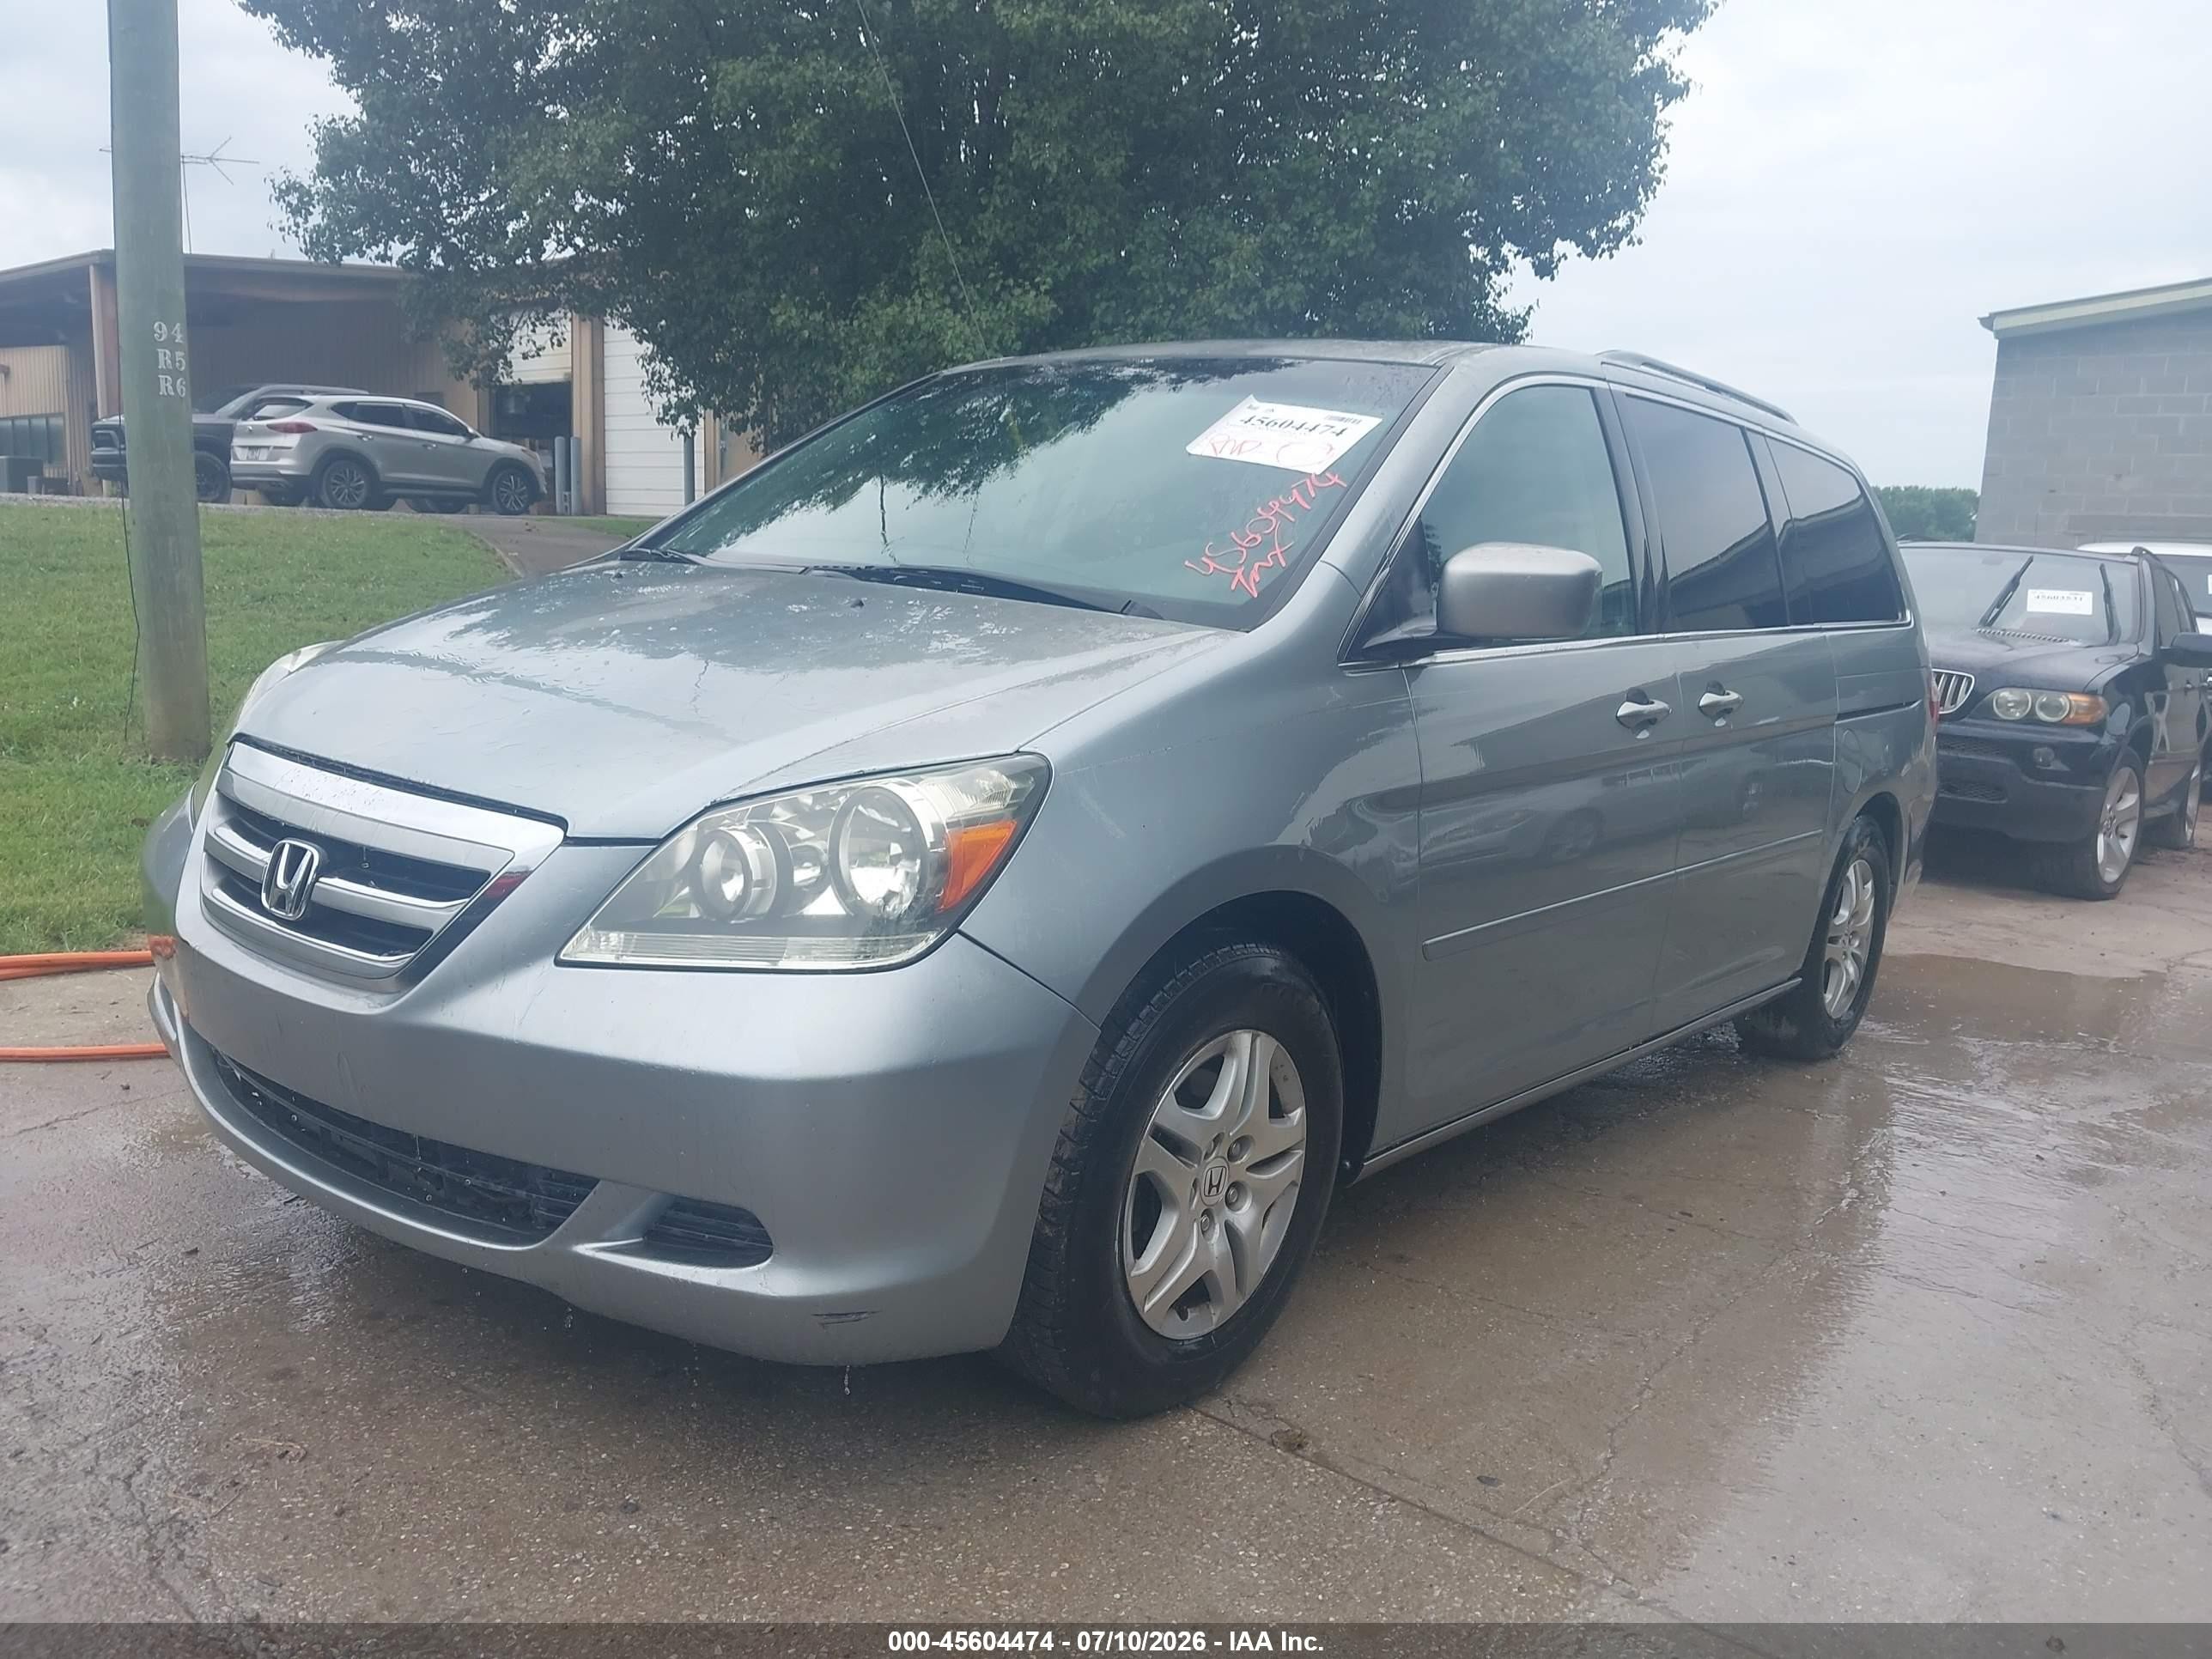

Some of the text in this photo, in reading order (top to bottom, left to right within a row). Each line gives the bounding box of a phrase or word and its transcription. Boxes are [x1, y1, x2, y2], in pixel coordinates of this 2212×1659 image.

[153, 321, 184, 343] 94
[156, 348, 186, 371] R5
[157, 374, 186, 398] R6
[1239, 414, 1348, 437] 45604474
